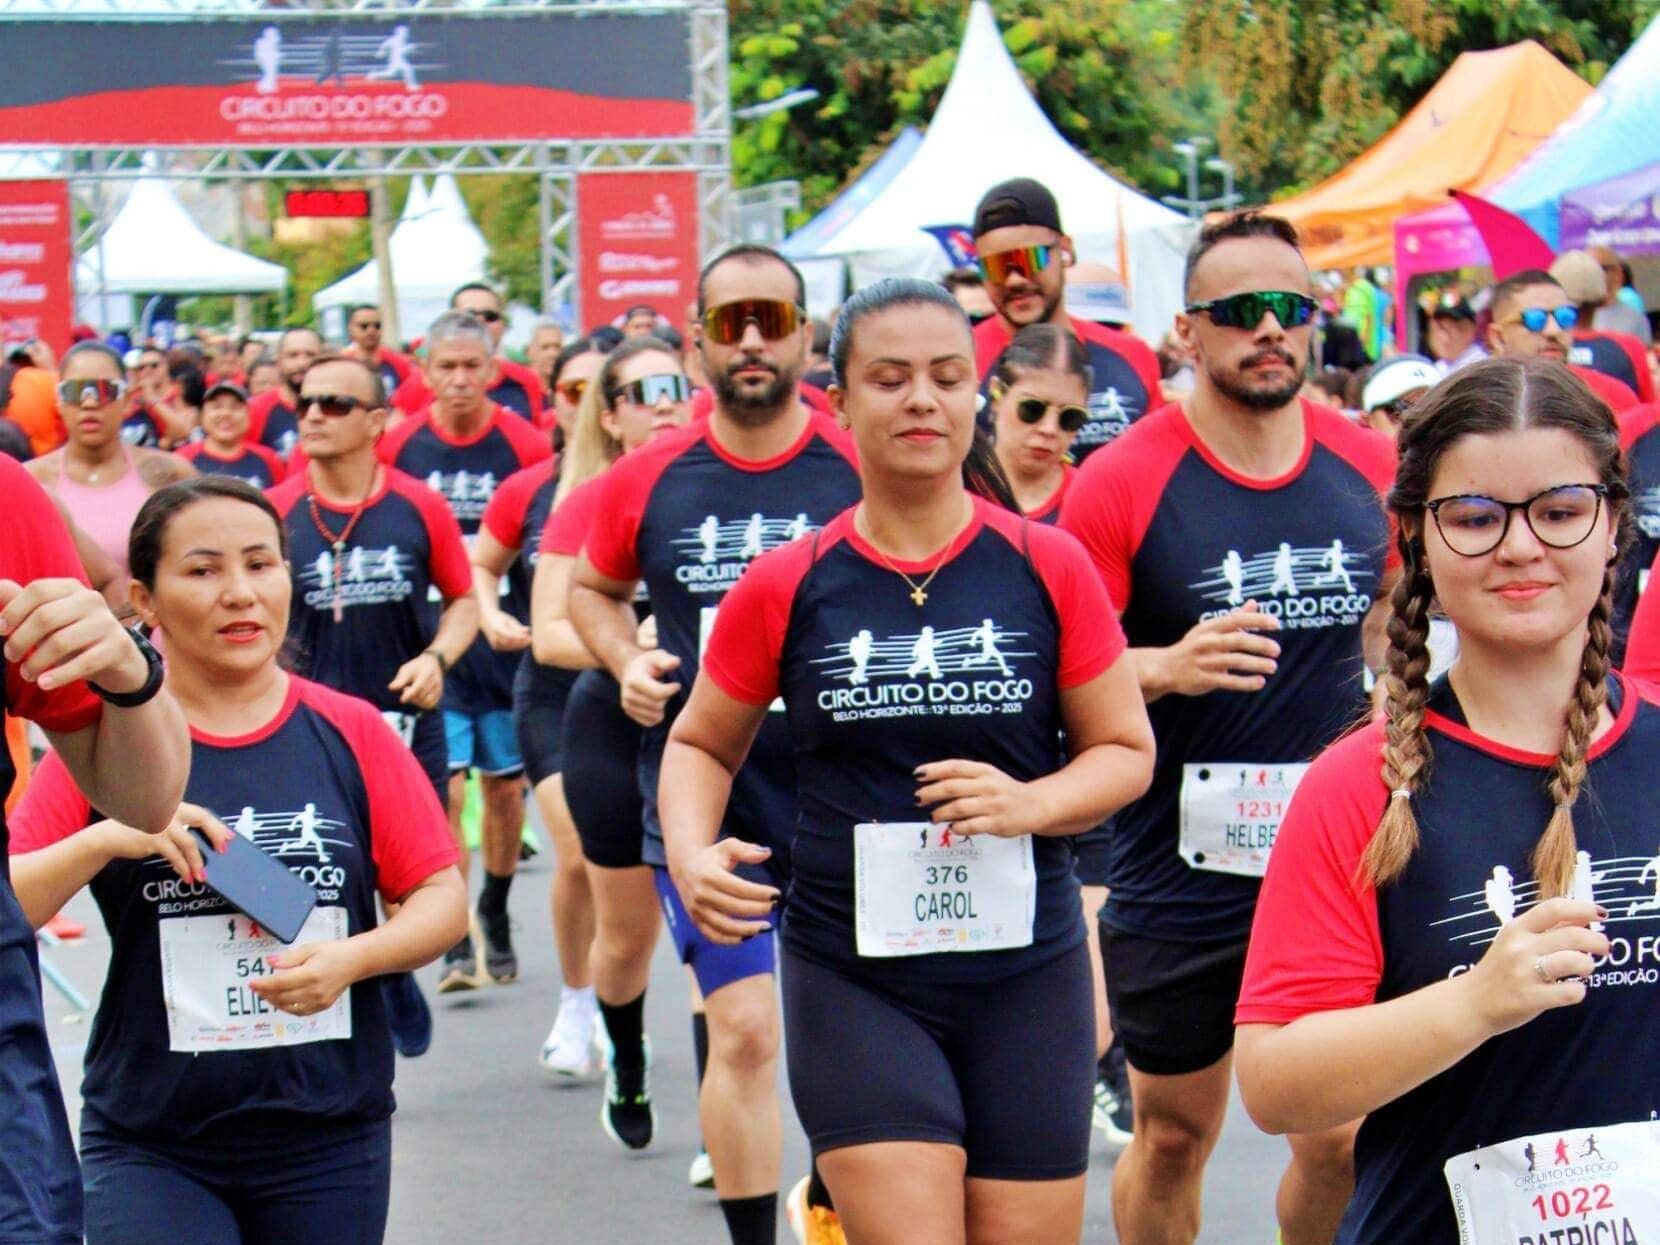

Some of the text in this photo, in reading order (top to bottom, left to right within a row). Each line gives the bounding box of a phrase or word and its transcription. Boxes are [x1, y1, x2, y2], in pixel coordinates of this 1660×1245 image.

[331, 94, 371, 119] DO
[1284, 596, 1317, 618] DO
[1319, 594, 1370, 615] FOGO
[818, 679, 1033, 710] CIRCUITO DO FOGO
[833, 709, 858, 722] BELO
[950, 702, 992, 716] EDIÇÃO
[1002, 702, 1022, 713] 2025
[1237, 801, 1283, 818] 1231
[1226, 823, 1278, 848] HELBE
[926, 865, 968, 885] 376
[143, 878, 212, 901] CIRCU
[158, 903, 182, 914] BELO
[915, 892, 977, 922] CAROL
[1588, 973, 1606, 988] 13ª
[1606, 967, 1658, 986] EDIÇÃO
[227, 987, 278, 1016] ELIE
[1514, 1169, 1562, 1187] CIRCUITO
[1564, 1166, 1583, 1178] DO
[1585, 1161, 1619, 1175] FOGO
[1532, 1183, 1614, 1221] 1022
